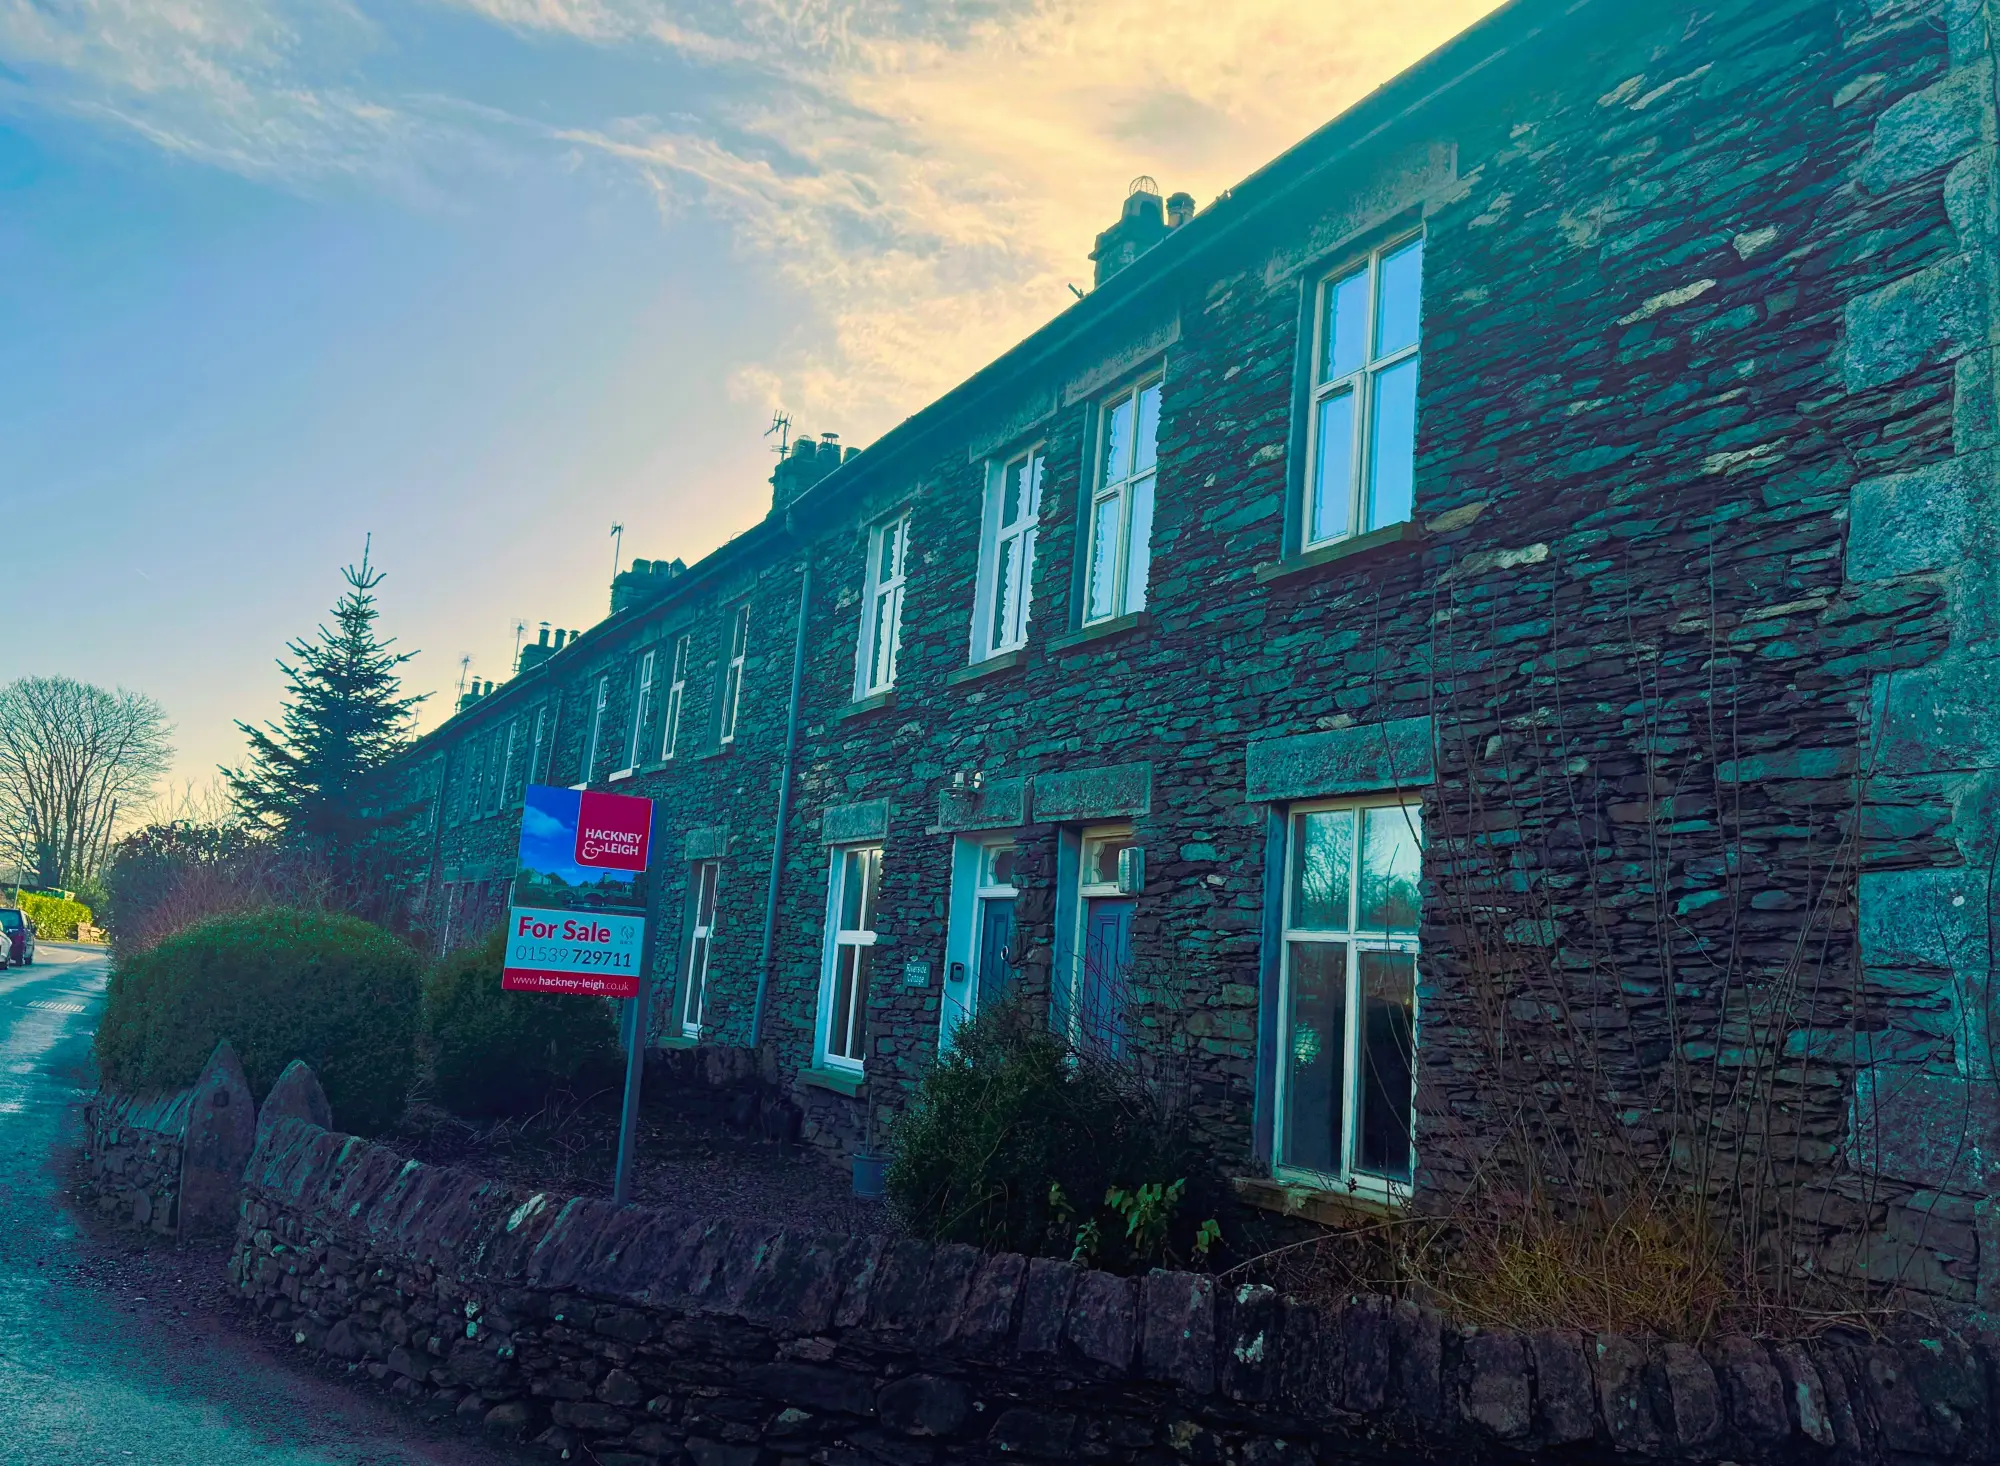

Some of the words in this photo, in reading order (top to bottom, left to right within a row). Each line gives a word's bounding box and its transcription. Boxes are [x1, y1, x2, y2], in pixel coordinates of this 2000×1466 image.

[585, 828, 642, 844] HACKNEY
[604, 843, 639, 856] LEIGH
[518, 916, 558, 939] For
[562, 920, 611, 943] Sale
[515, 945, 568, 963] 01539
[572, 949, 631, 968] 729711
[512, 975, 629, 991] www.hackney-leigh.co.uk
